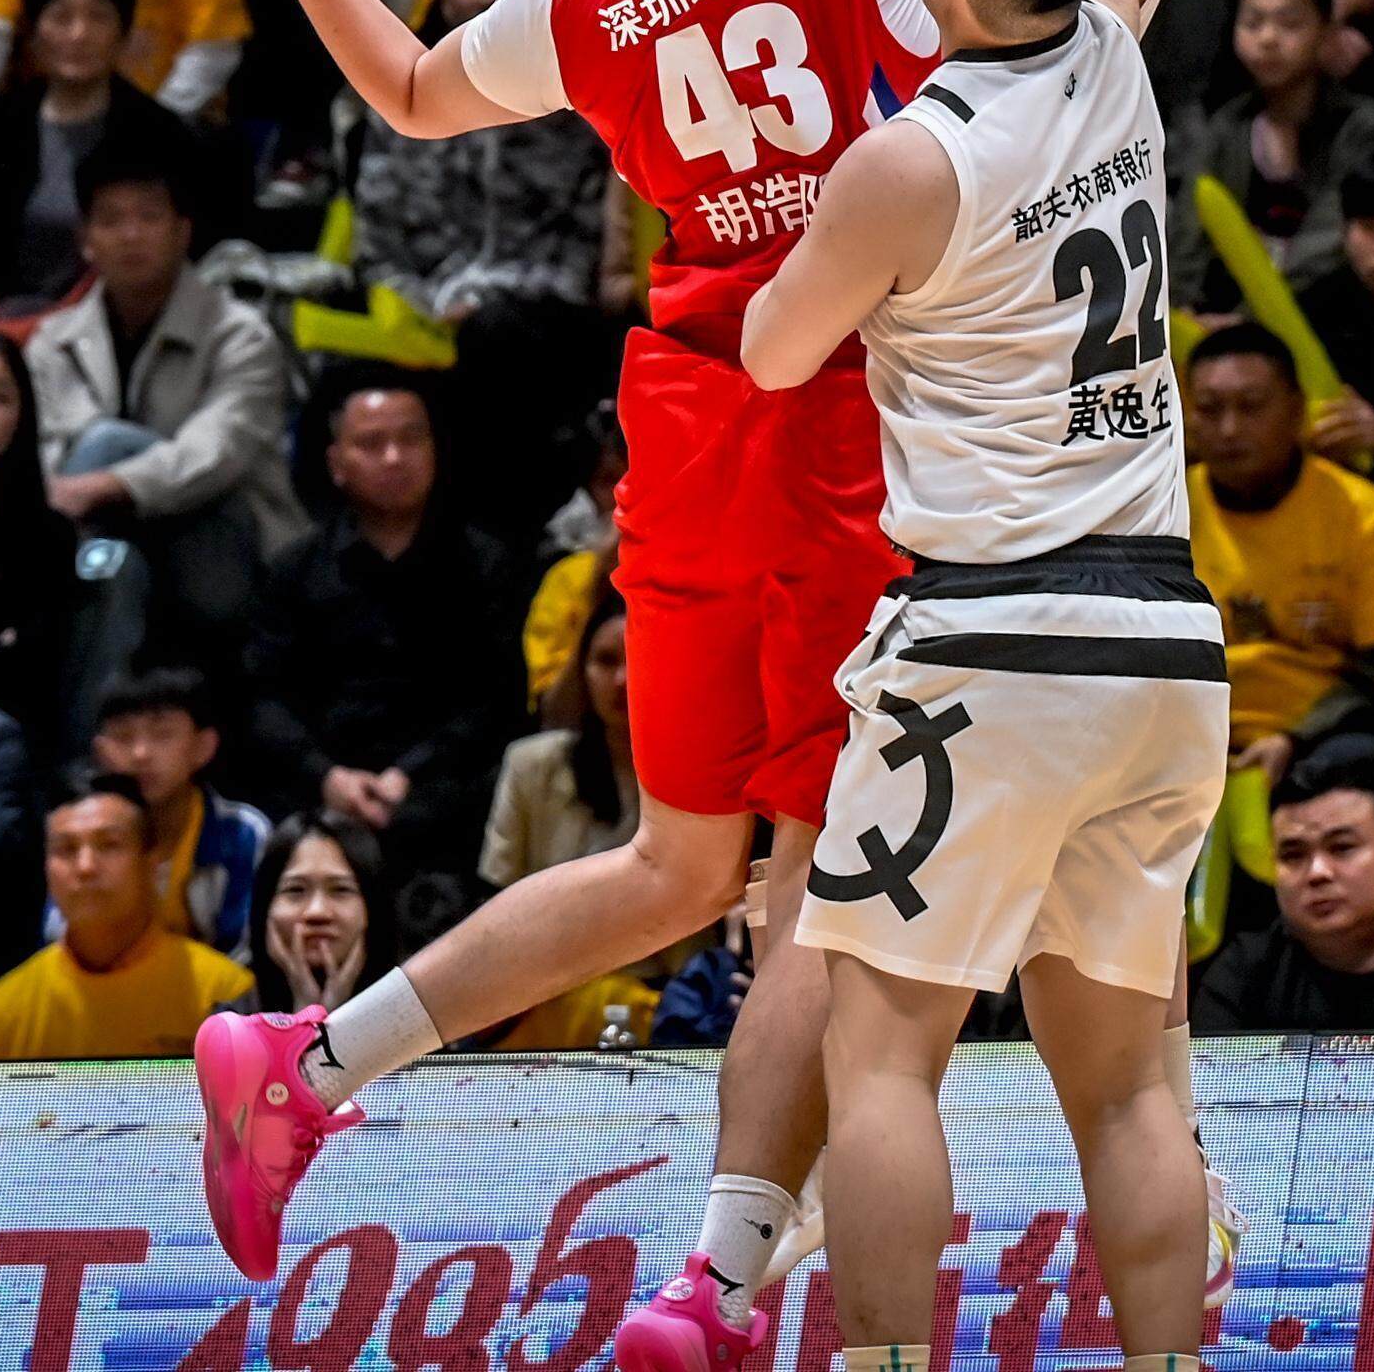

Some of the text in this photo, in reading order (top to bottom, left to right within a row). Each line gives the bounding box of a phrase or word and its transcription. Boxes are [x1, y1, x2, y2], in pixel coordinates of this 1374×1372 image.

[655, 2, 833, 174] 43
[1011, 138, 1152, 243] 韶关农商银行
[1053, 199, 1167, 388] 22
